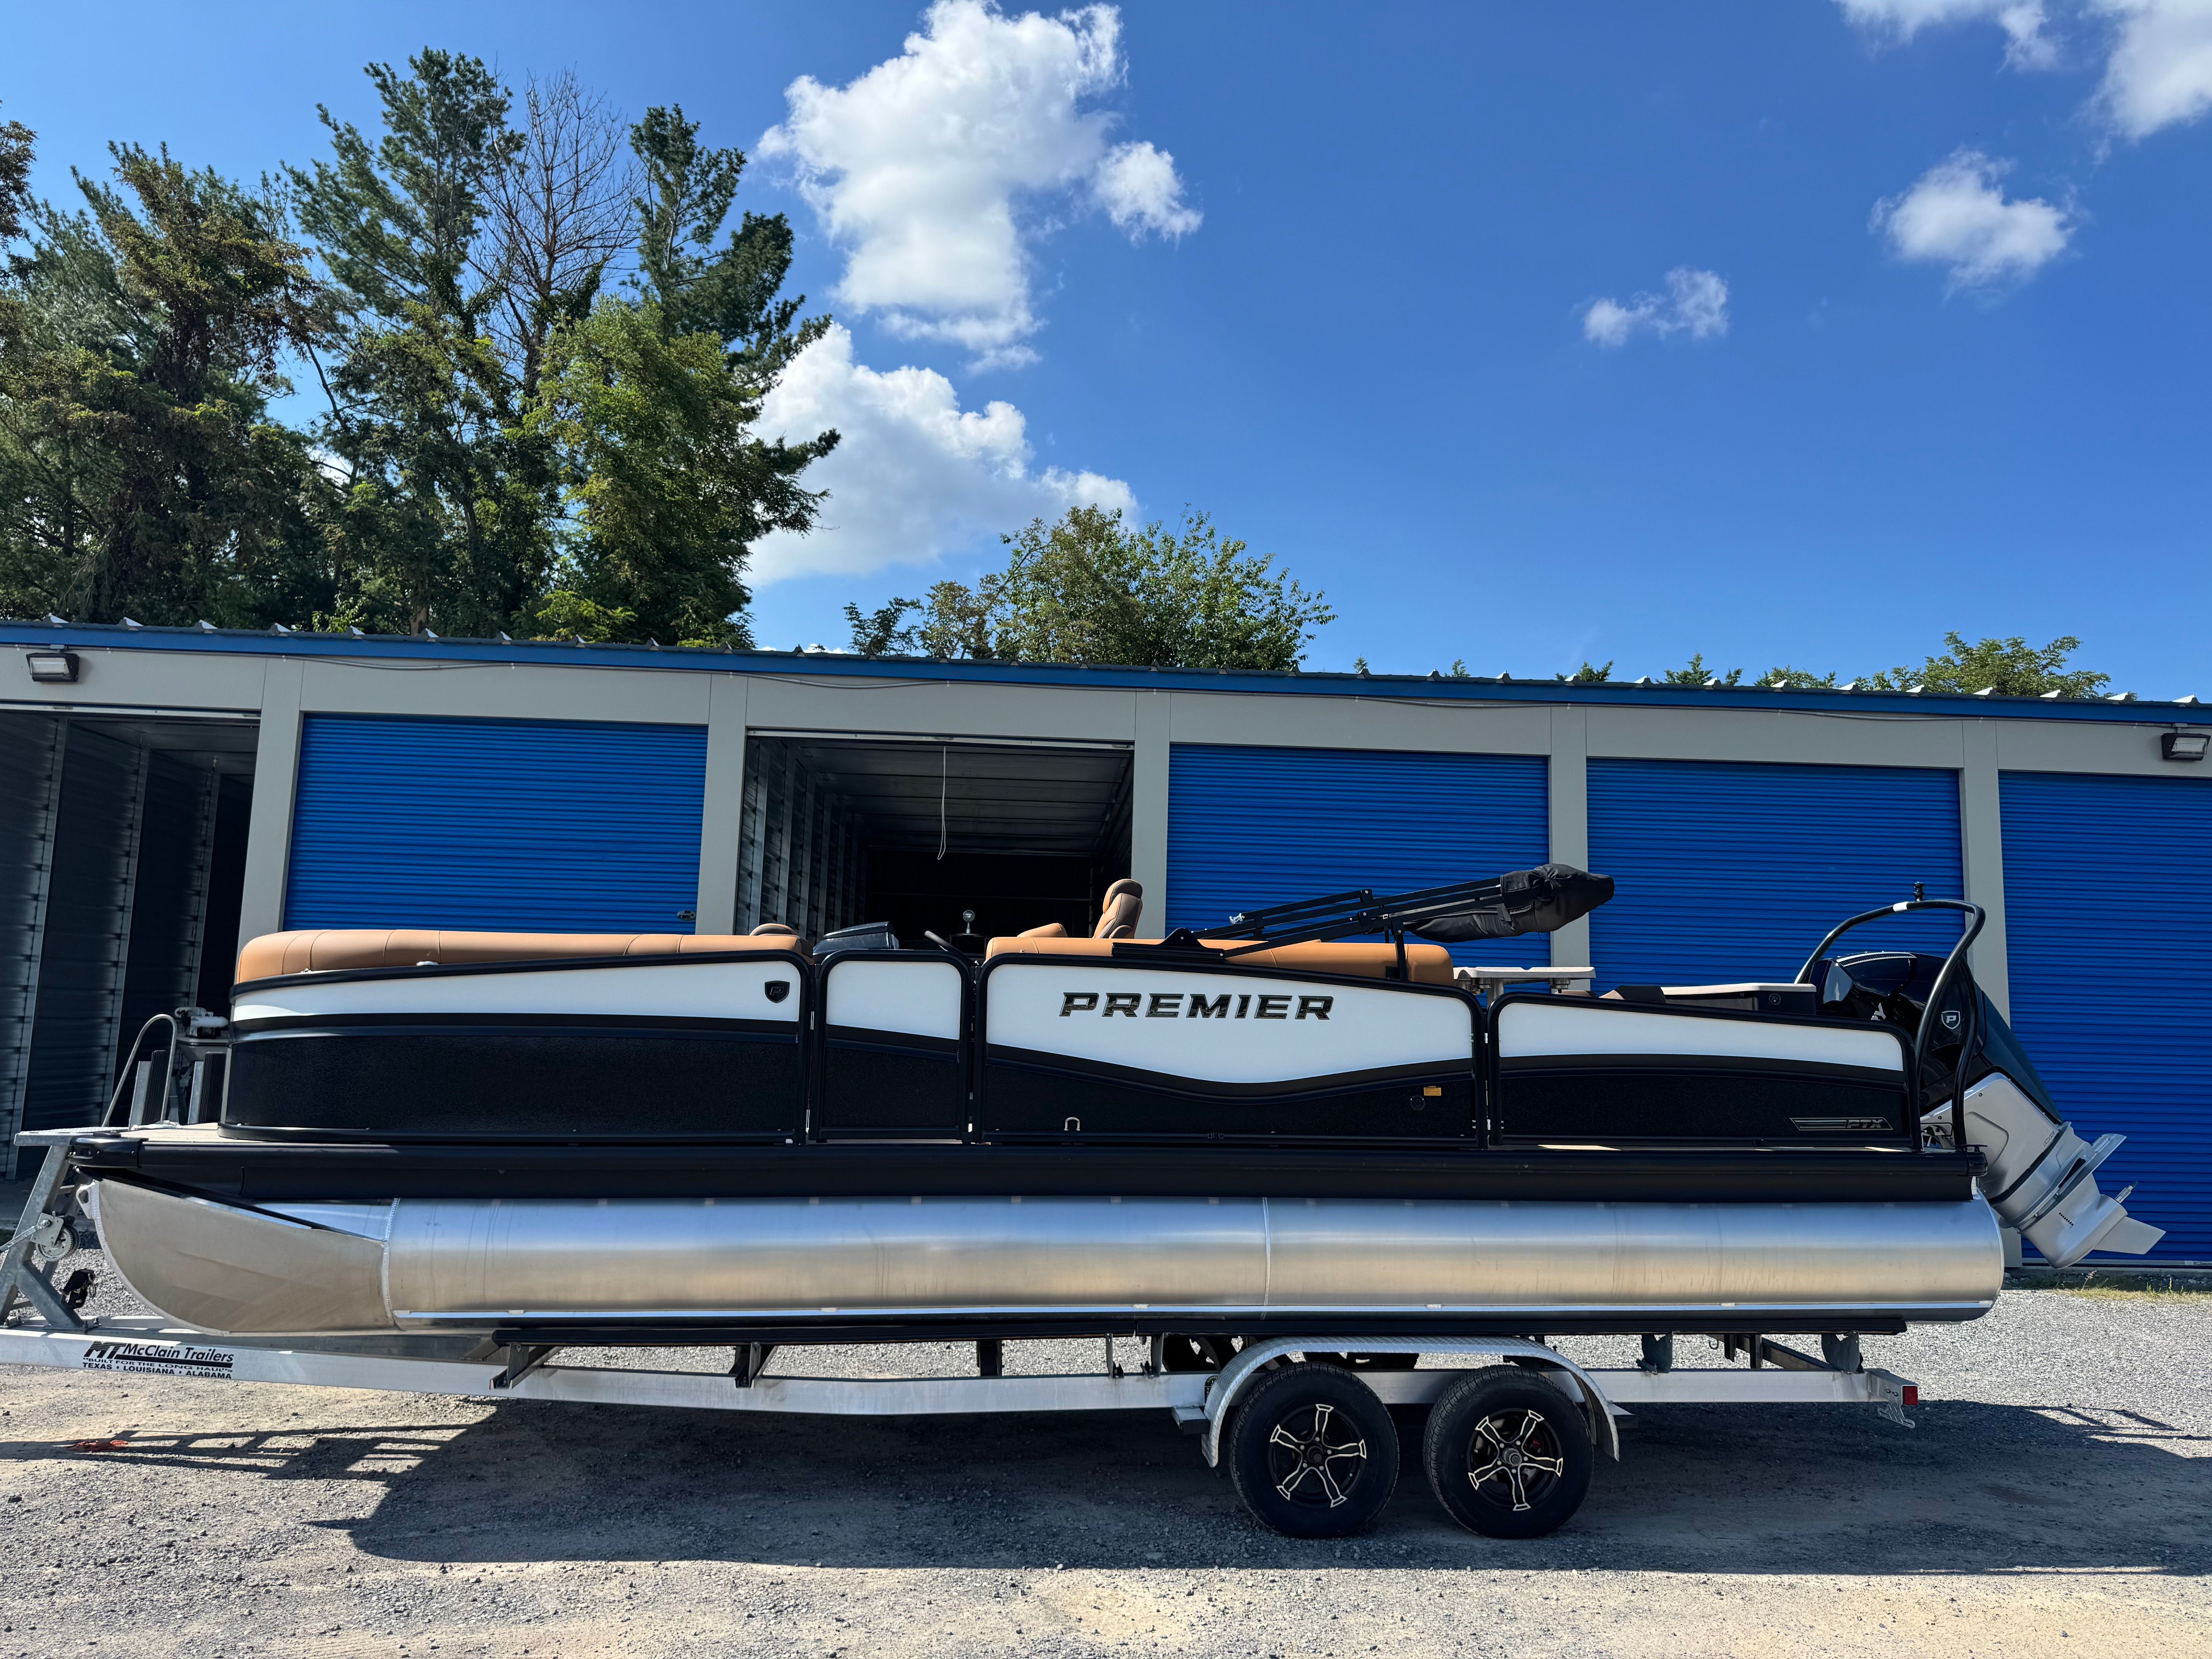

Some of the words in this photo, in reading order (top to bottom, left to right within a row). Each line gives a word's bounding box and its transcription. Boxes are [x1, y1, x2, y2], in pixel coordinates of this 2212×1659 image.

[769, 986, 784, 995] P
[1059, 992, 1334, 1020] PREMIER
[1946, 1015, 1956, 1023] P
[1846, 1119, 1883, 1128] PTX
[122, 1343, 180, 1358] McClain
[184, 1347, 234, 1362] Trailers
[124, 1365, 175, 1375] LOUISIANA
[185, 1370, 232, 1379] ALABAMA
